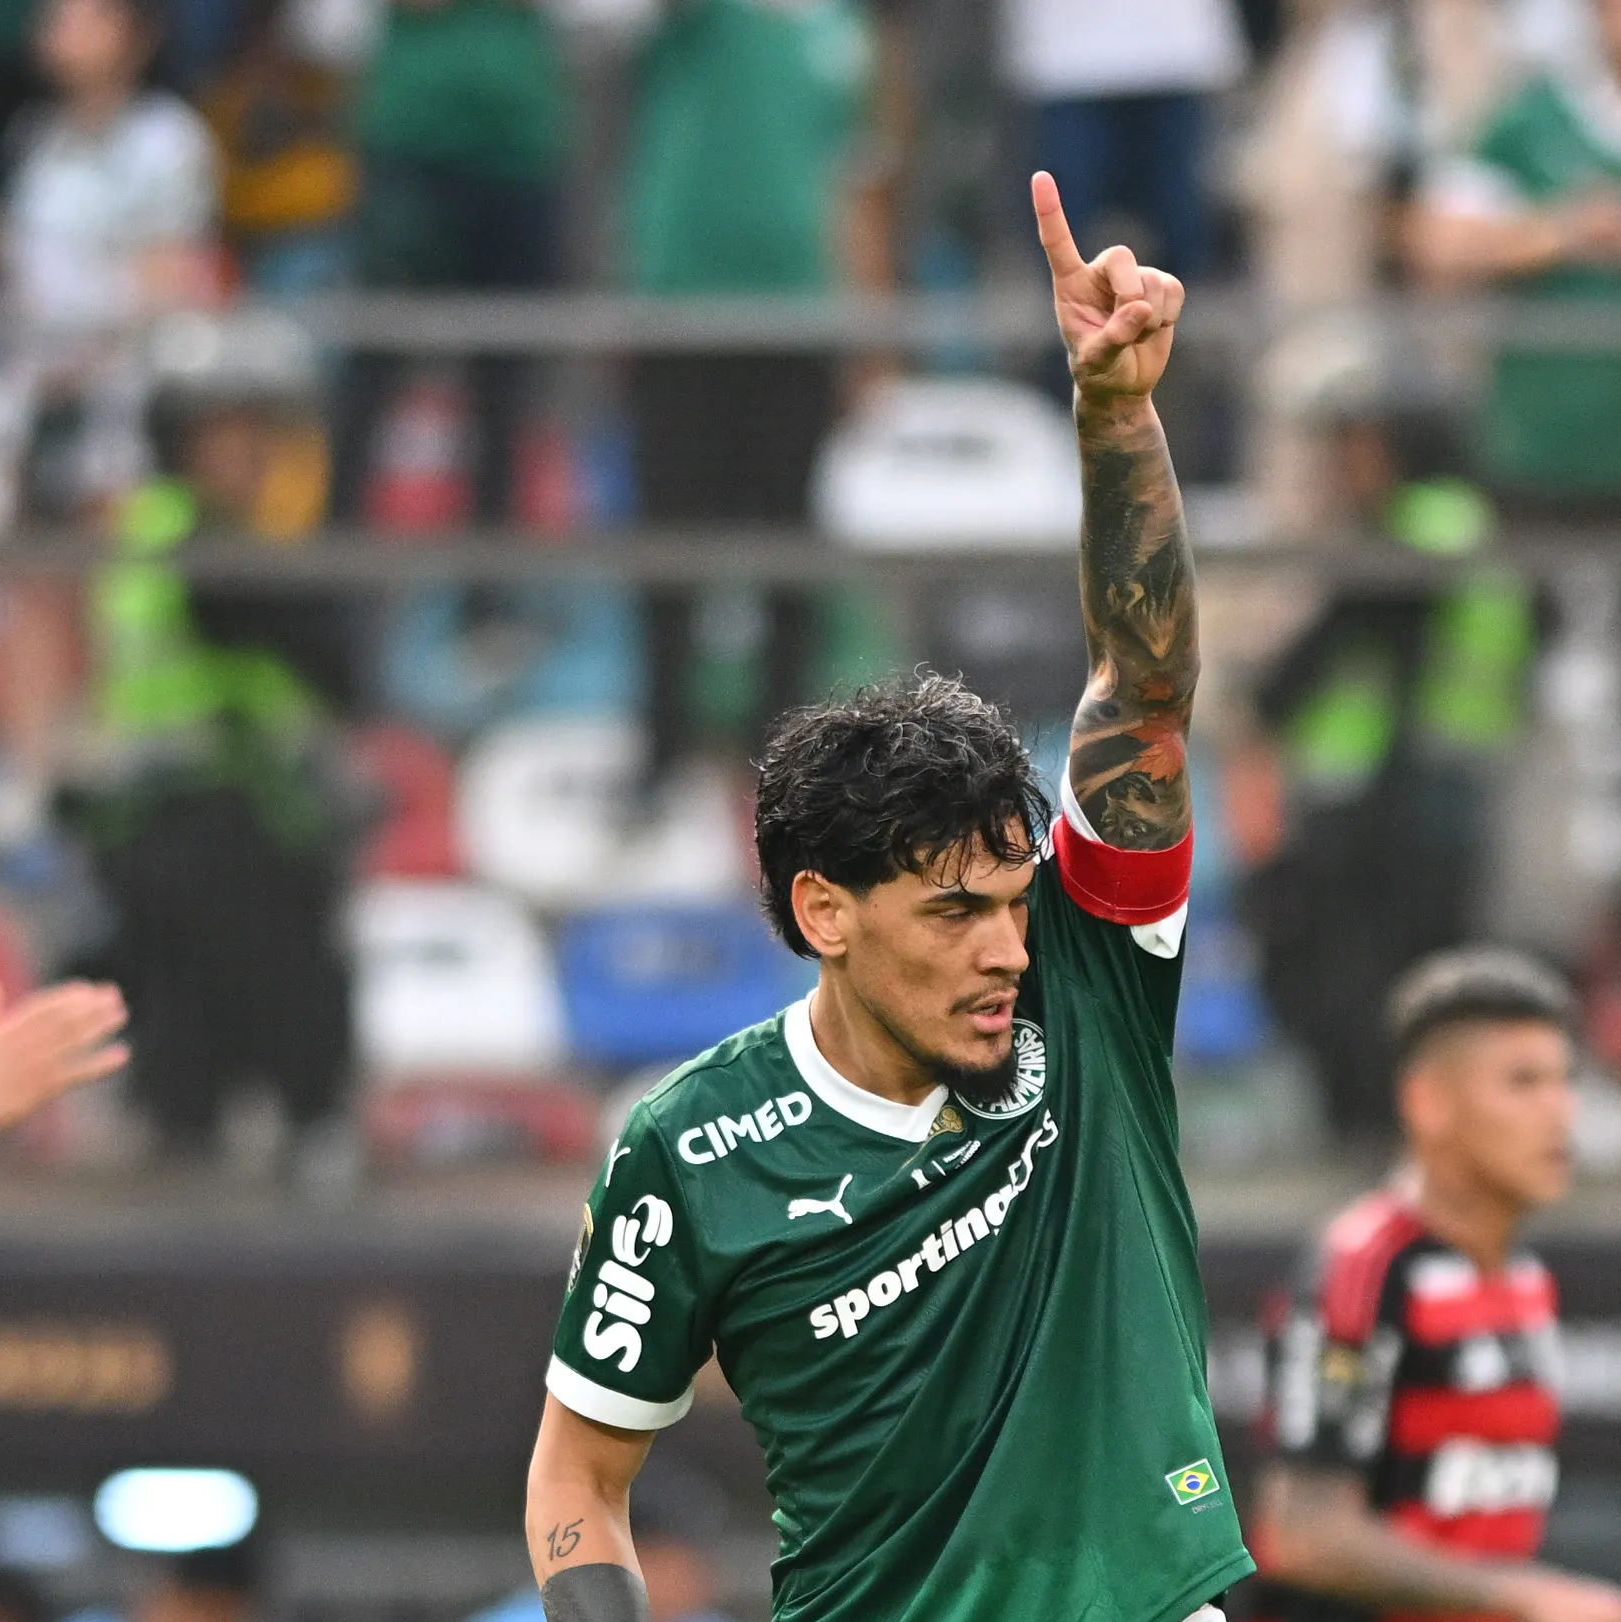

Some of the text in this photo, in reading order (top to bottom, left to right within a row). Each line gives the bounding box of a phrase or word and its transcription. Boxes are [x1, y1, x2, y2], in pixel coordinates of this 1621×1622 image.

[978, 1027, 1046, 1112] ALMEIRAS
[678, 1091, 813, 1165] CIMED
[809, 1108, 1060, 1340] sporting
[546, 1518, 584, 1562] 15
